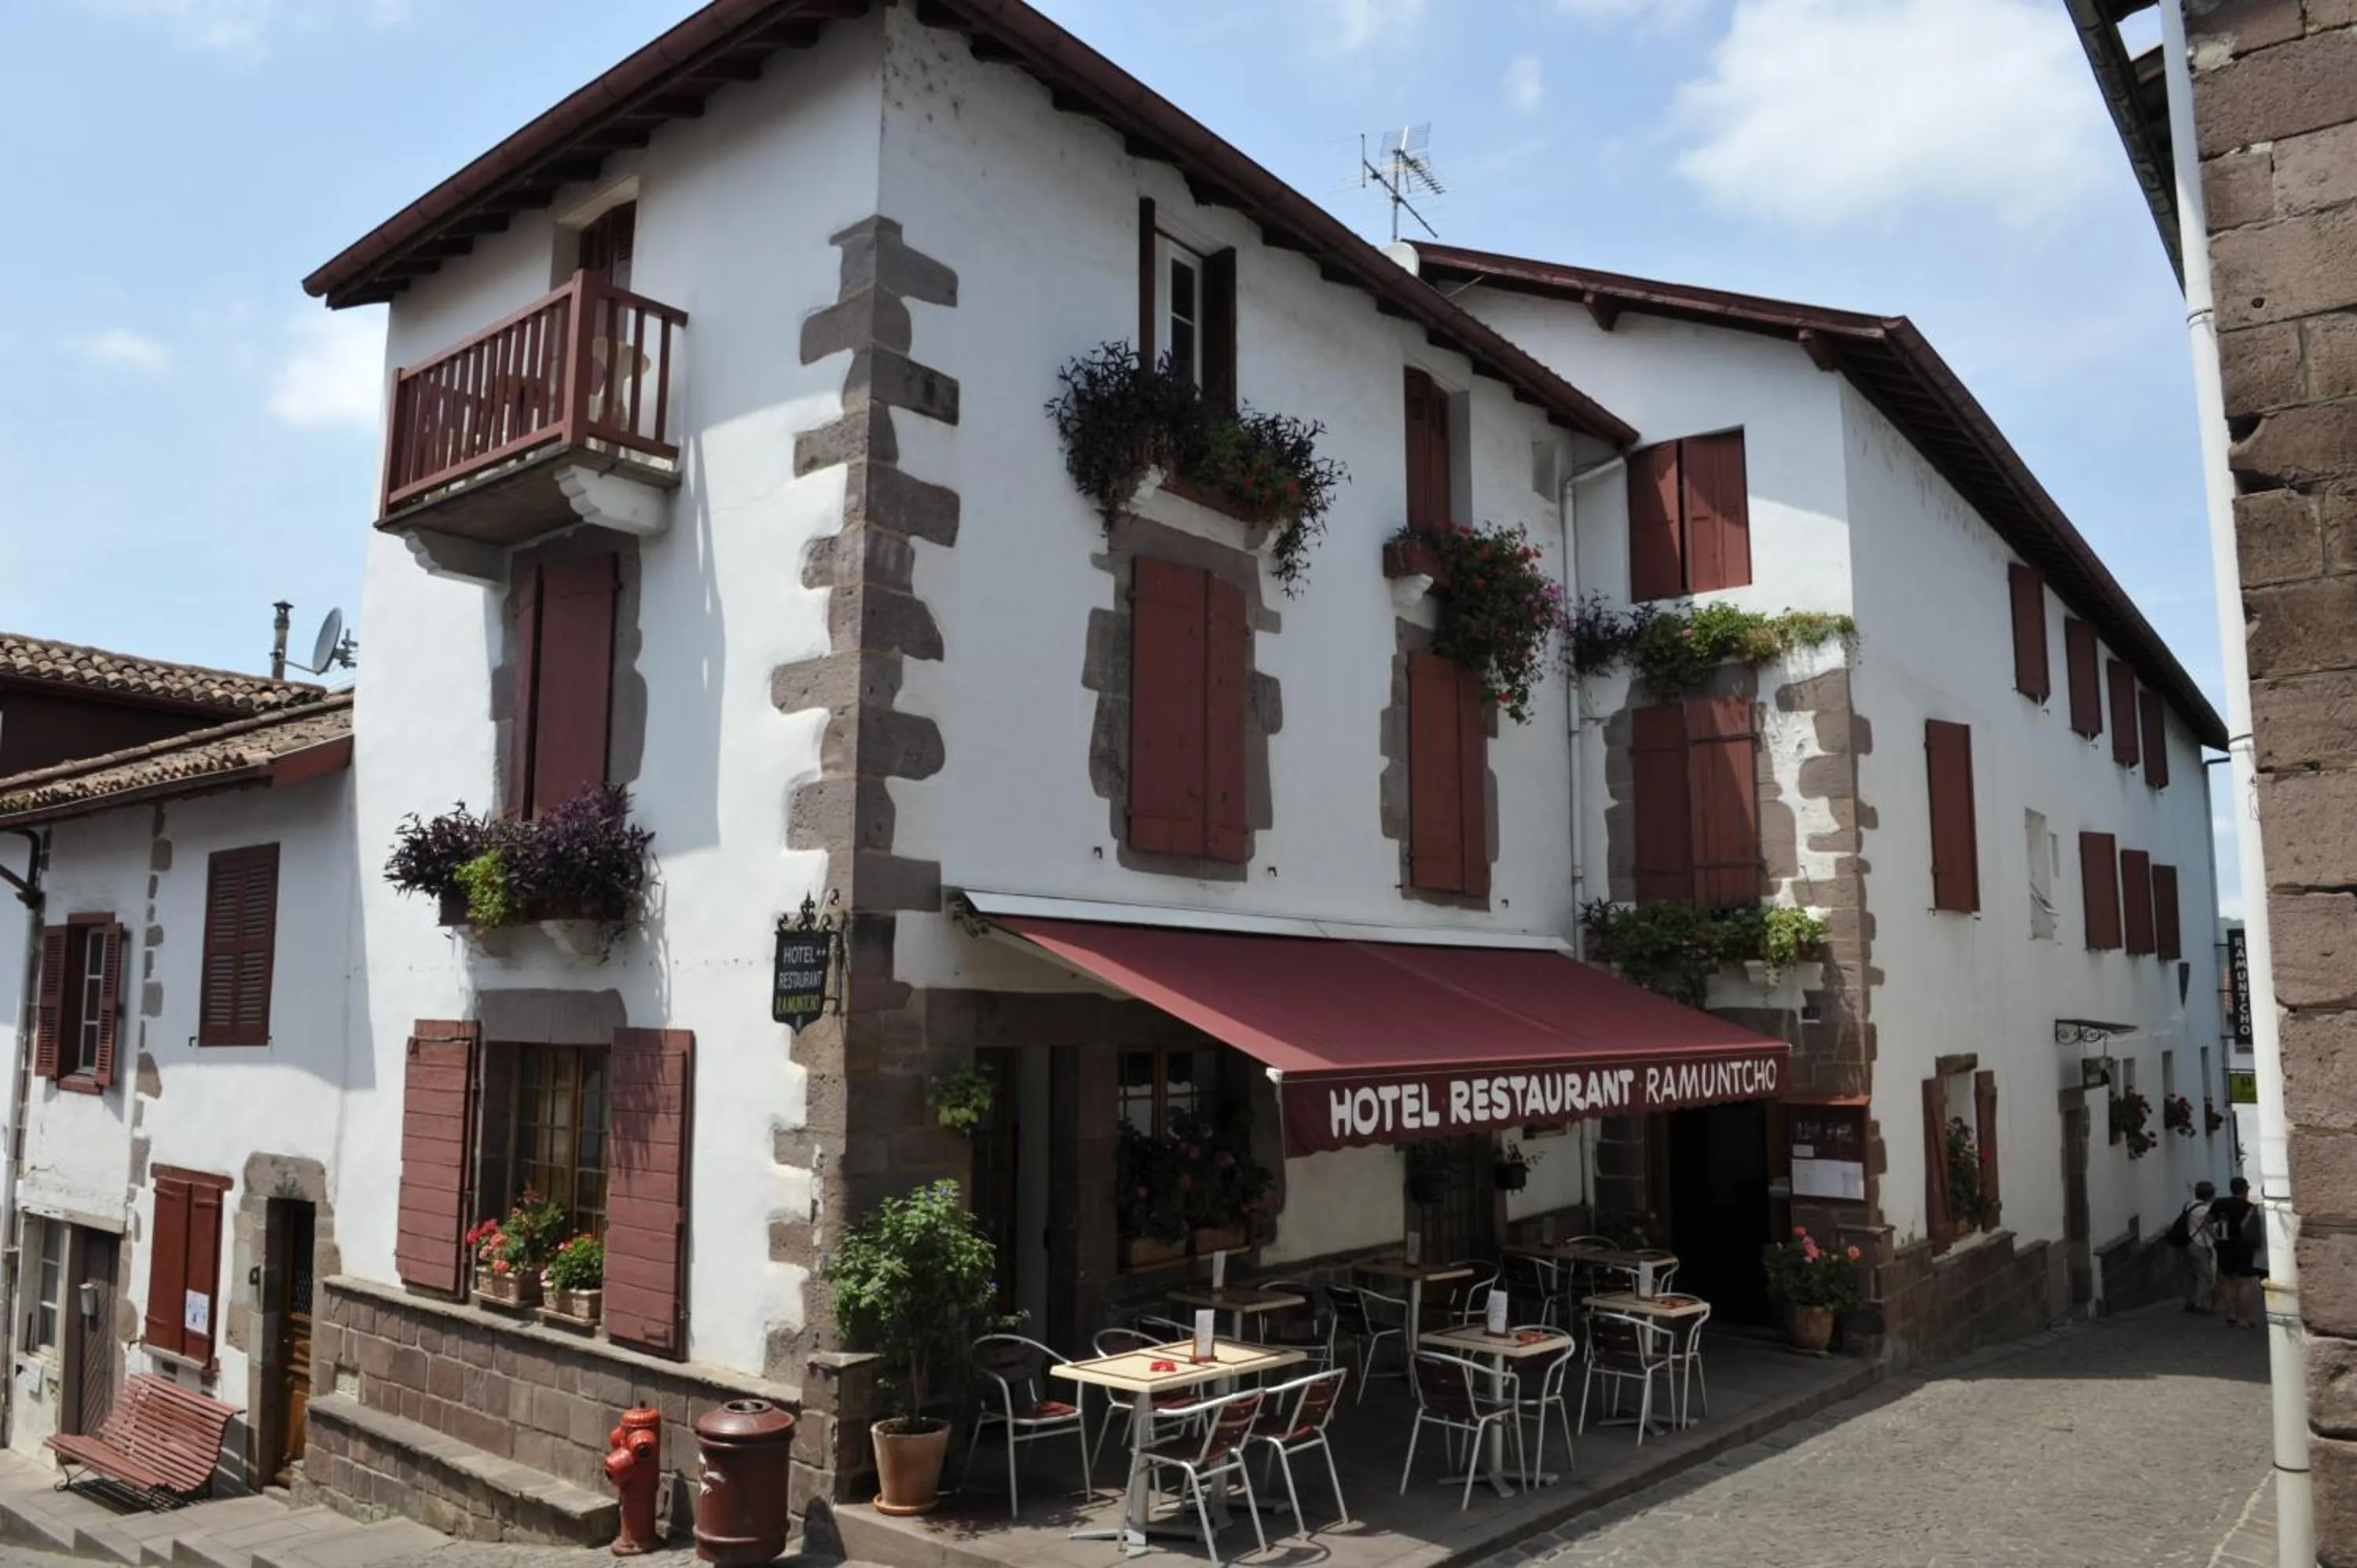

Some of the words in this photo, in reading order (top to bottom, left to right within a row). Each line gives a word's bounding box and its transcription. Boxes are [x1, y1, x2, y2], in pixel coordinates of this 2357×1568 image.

[783, 945, 816, 964] HOTEL
[778, 970, 823, 989] RESTAURANT
[2234, 936, 2251, 1035] RAMUNTCHO
[1329, 1083, 1440, 1138] HOTEL
[1450, 1068, 1635, 1125] RESTAURANT
[1646, 1058, 1777, 1105] RAMUNTCHO
